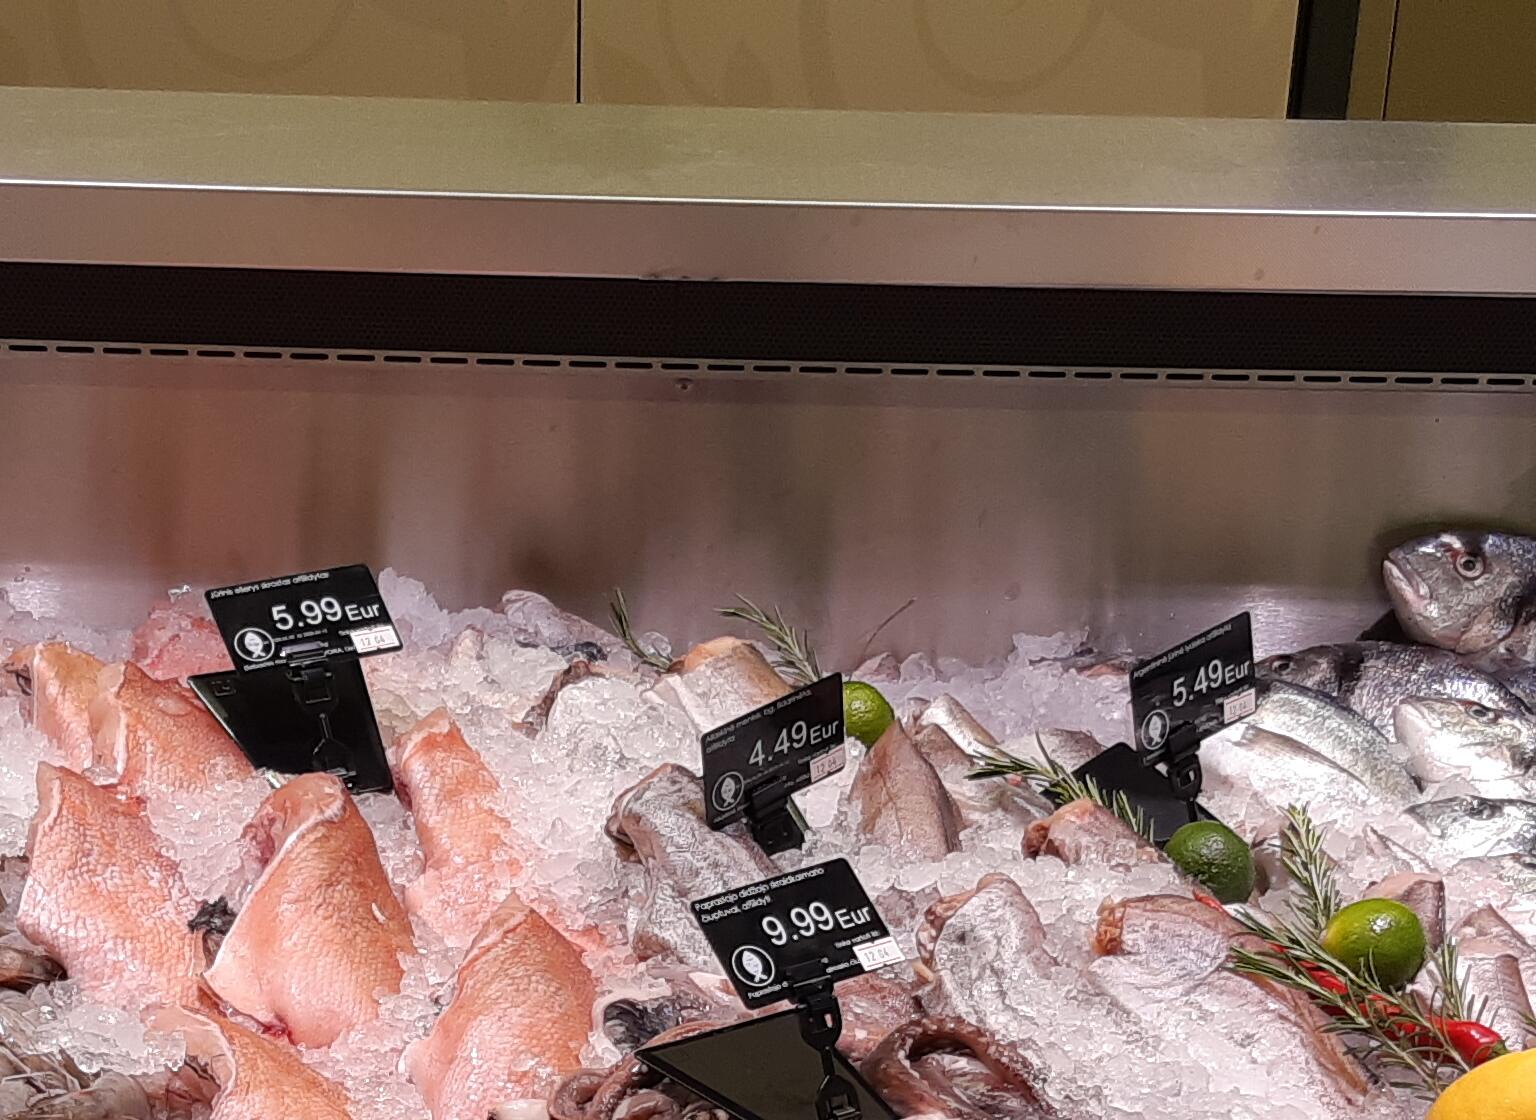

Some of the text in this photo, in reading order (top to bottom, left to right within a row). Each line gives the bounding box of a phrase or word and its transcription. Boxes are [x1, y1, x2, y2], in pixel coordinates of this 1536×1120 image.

[271, 596, 343, 631] 5.99
[344, 603, 380, 622] Eur
[1173, 659, 1223, 707] 5.49
[1224, 660, 1250, 685] Eur
[749, 721, 807, 766] 4.49
[810, 720, 839, 745] Eur
[761, 901, 872, 946] 9.99 Eur
